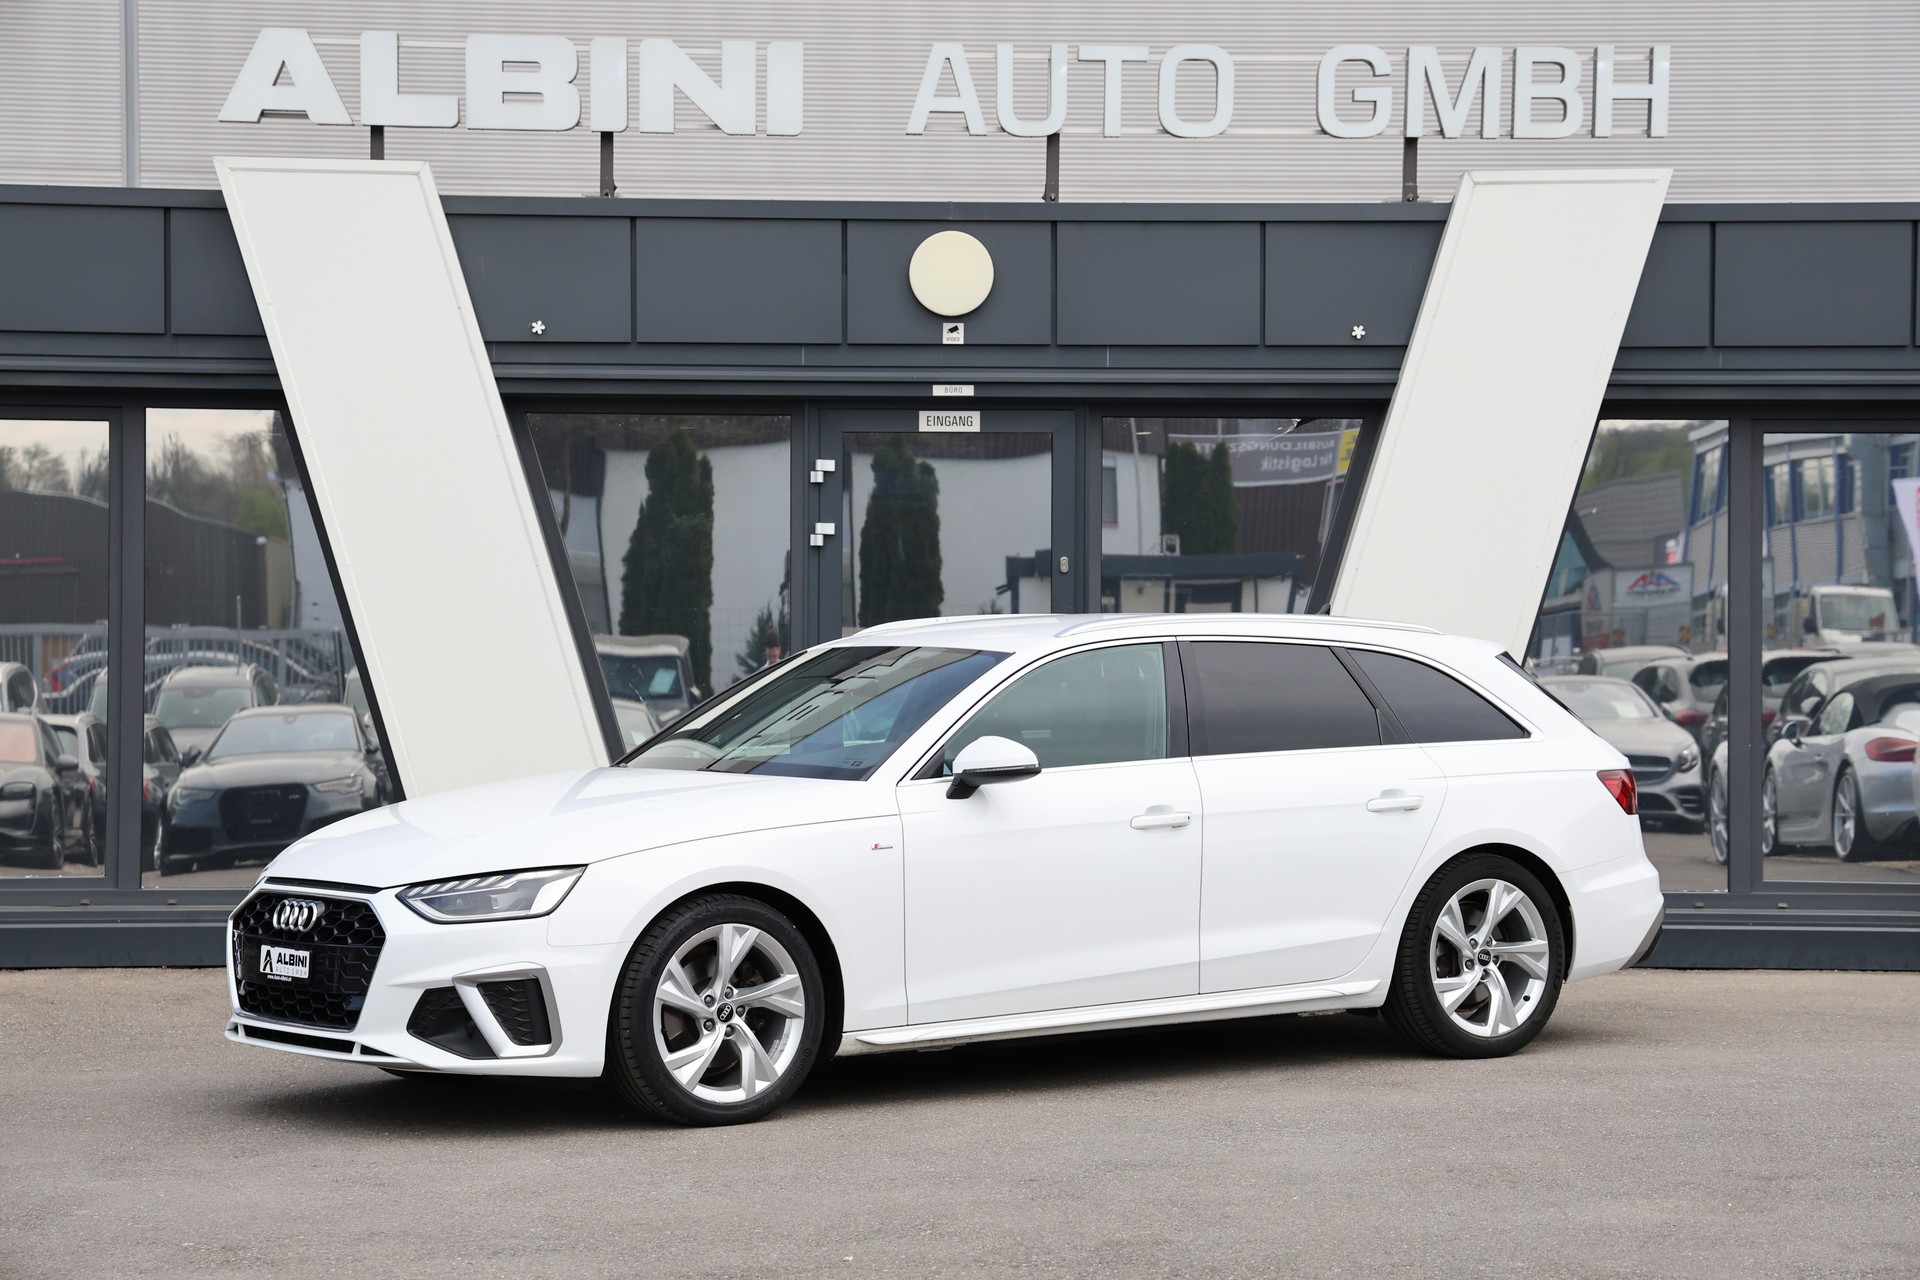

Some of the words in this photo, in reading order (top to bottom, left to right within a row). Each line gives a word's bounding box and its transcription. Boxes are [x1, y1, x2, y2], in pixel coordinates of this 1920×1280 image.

[217, 27, 804, 137] ALBINI
[905, 42, 1235, 138] AUTO
[1316, 43, 1672, 139] GMBH
[944, 385, 963, 394] BÜRO
[926, 415, 973, 427] EINGANG
[276, 952, 307, 968] ALBINI
